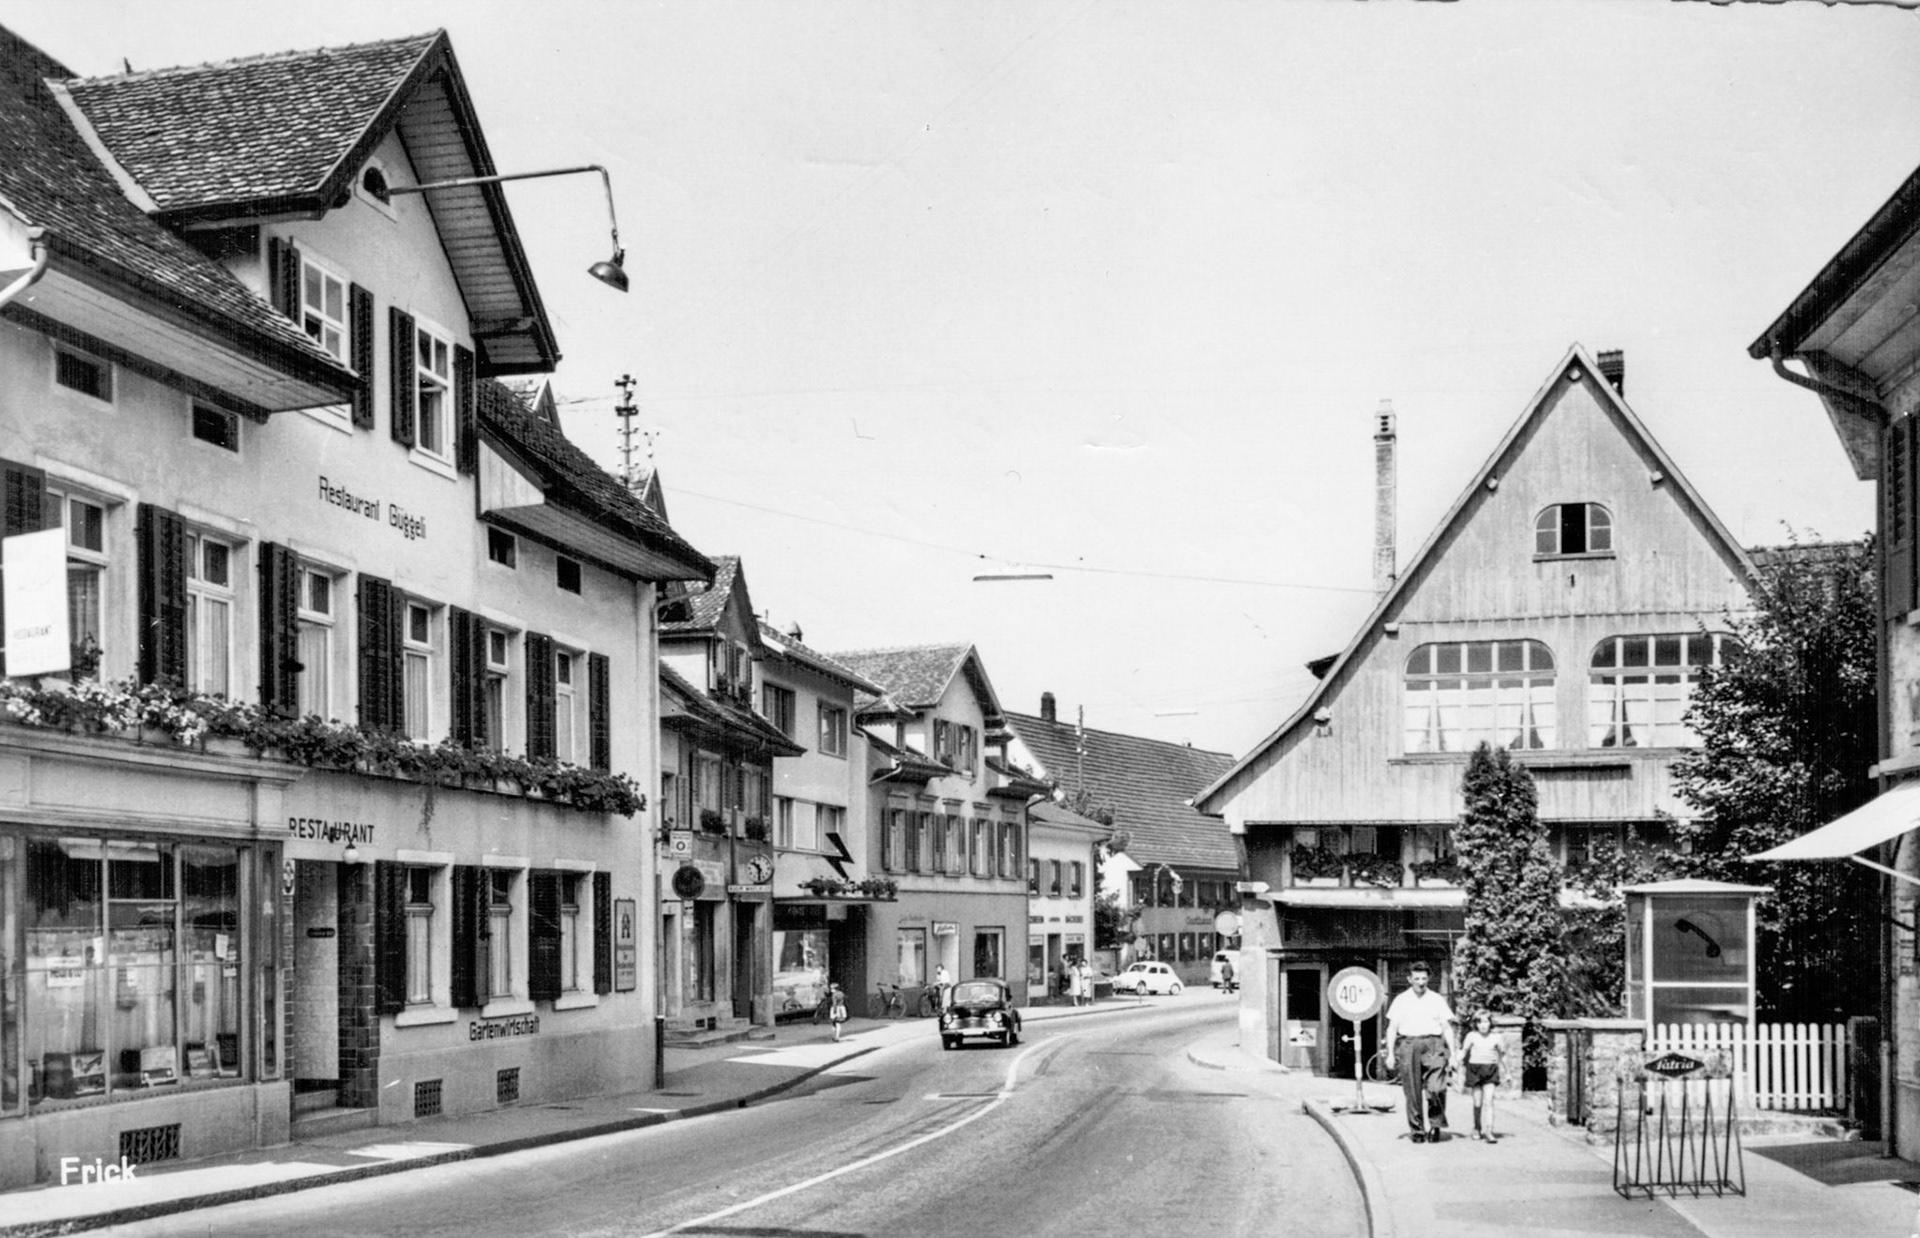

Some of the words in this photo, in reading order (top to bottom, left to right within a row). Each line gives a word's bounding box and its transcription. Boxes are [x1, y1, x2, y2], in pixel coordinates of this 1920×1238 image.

[318, 474, 380, 521] Restaurant
[288, 816, 375, 844] RESTAURANT
[1339, 985, 1358, 1005] 40
[469, 1015, 540, 1041] Gartenwirtschaft
